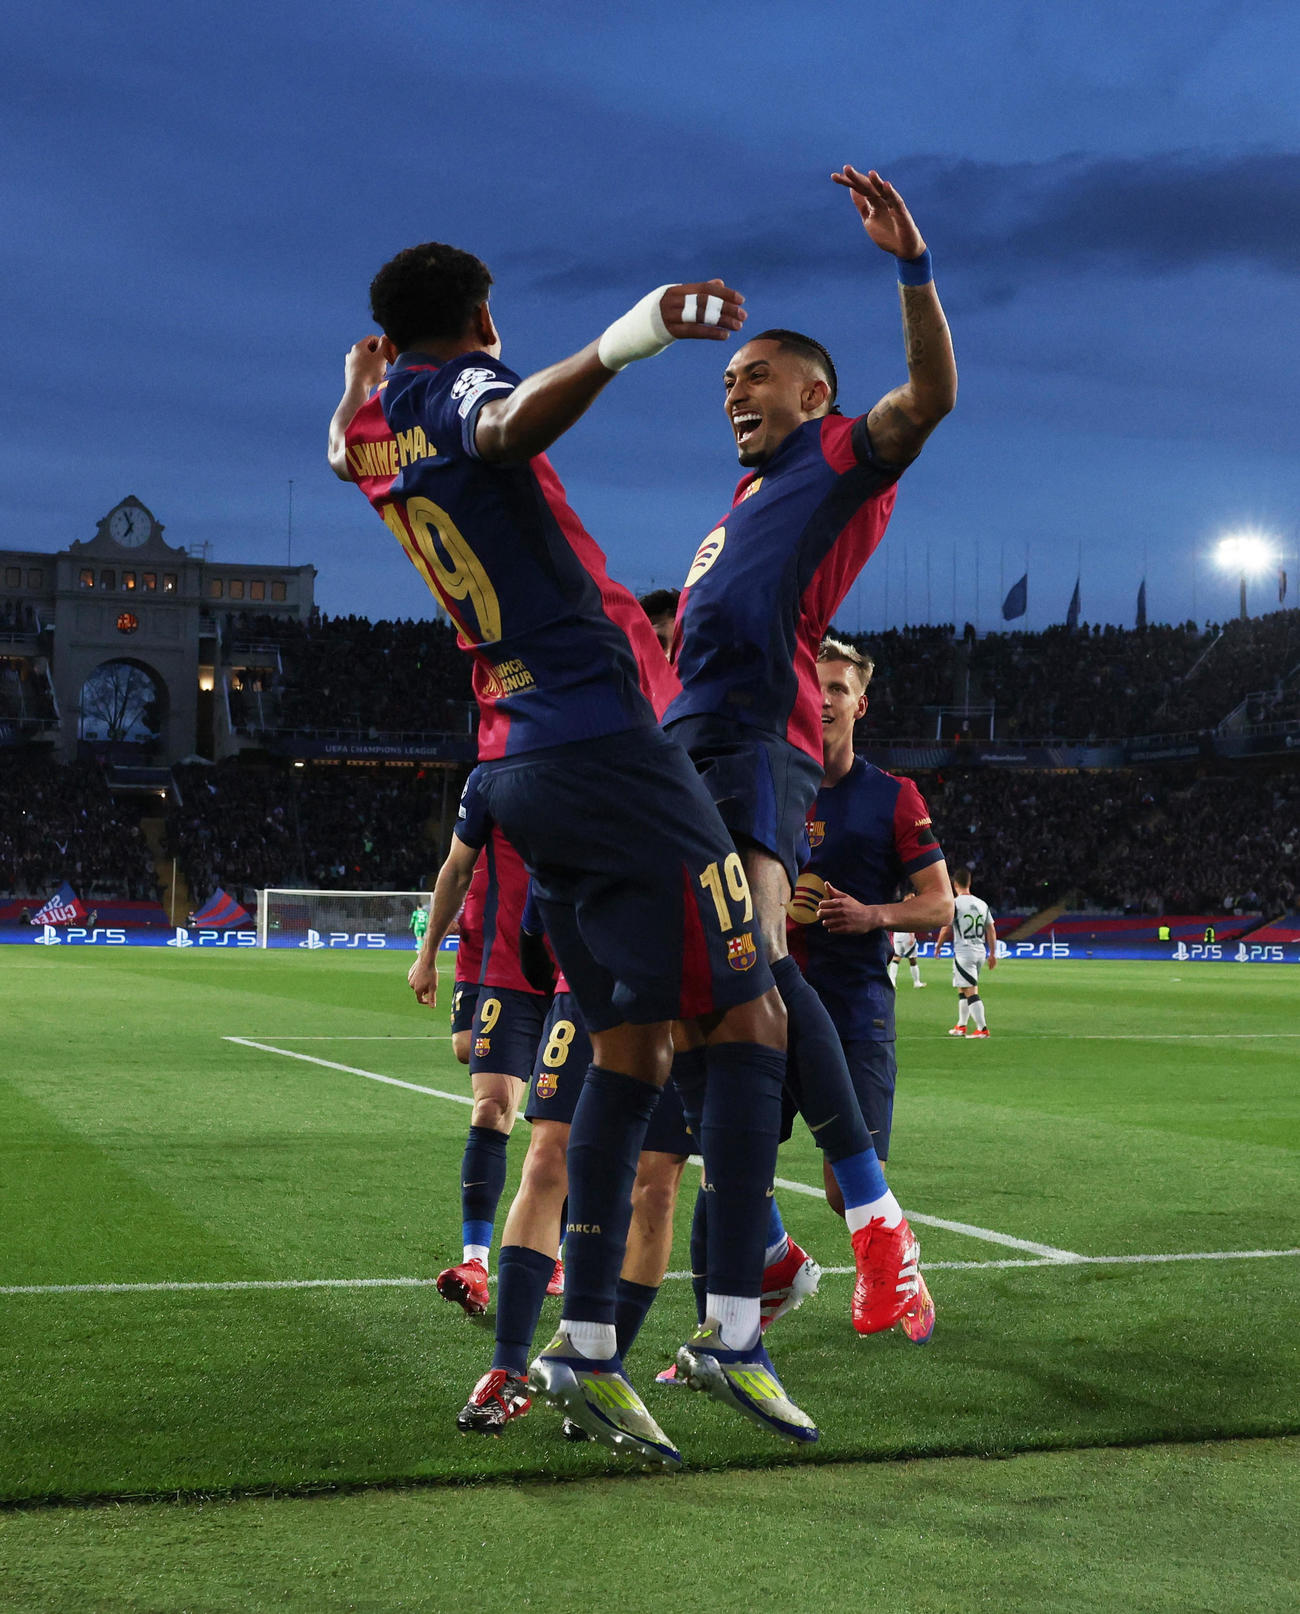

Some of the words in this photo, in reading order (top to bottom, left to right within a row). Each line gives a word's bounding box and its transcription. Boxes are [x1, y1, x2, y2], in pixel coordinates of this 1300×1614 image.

[382, 496, 502, 646] 19
[325, 745, 348, 754] UEFA
[350, 745, 402, 755] CHAMPIONS
[404, 746, 438, 756] LEAGUE
[699, 852, 753, 932] 19
[963, 913, 985, 939] 26
[67, 928, 127, 944] PS5
[199, 930, 256, 946] PS5
[330, 932, 386, 948] PS5
[916, 942, 952, 956] S5
[1016, 942, 1070, 958] PS5
[1191, 944, 1222, 959] PS5
[1251, 945, 1284, 960] PS5
[480, 998, 502, 1034] 9
[542, 1020, 576, 1068] 8
